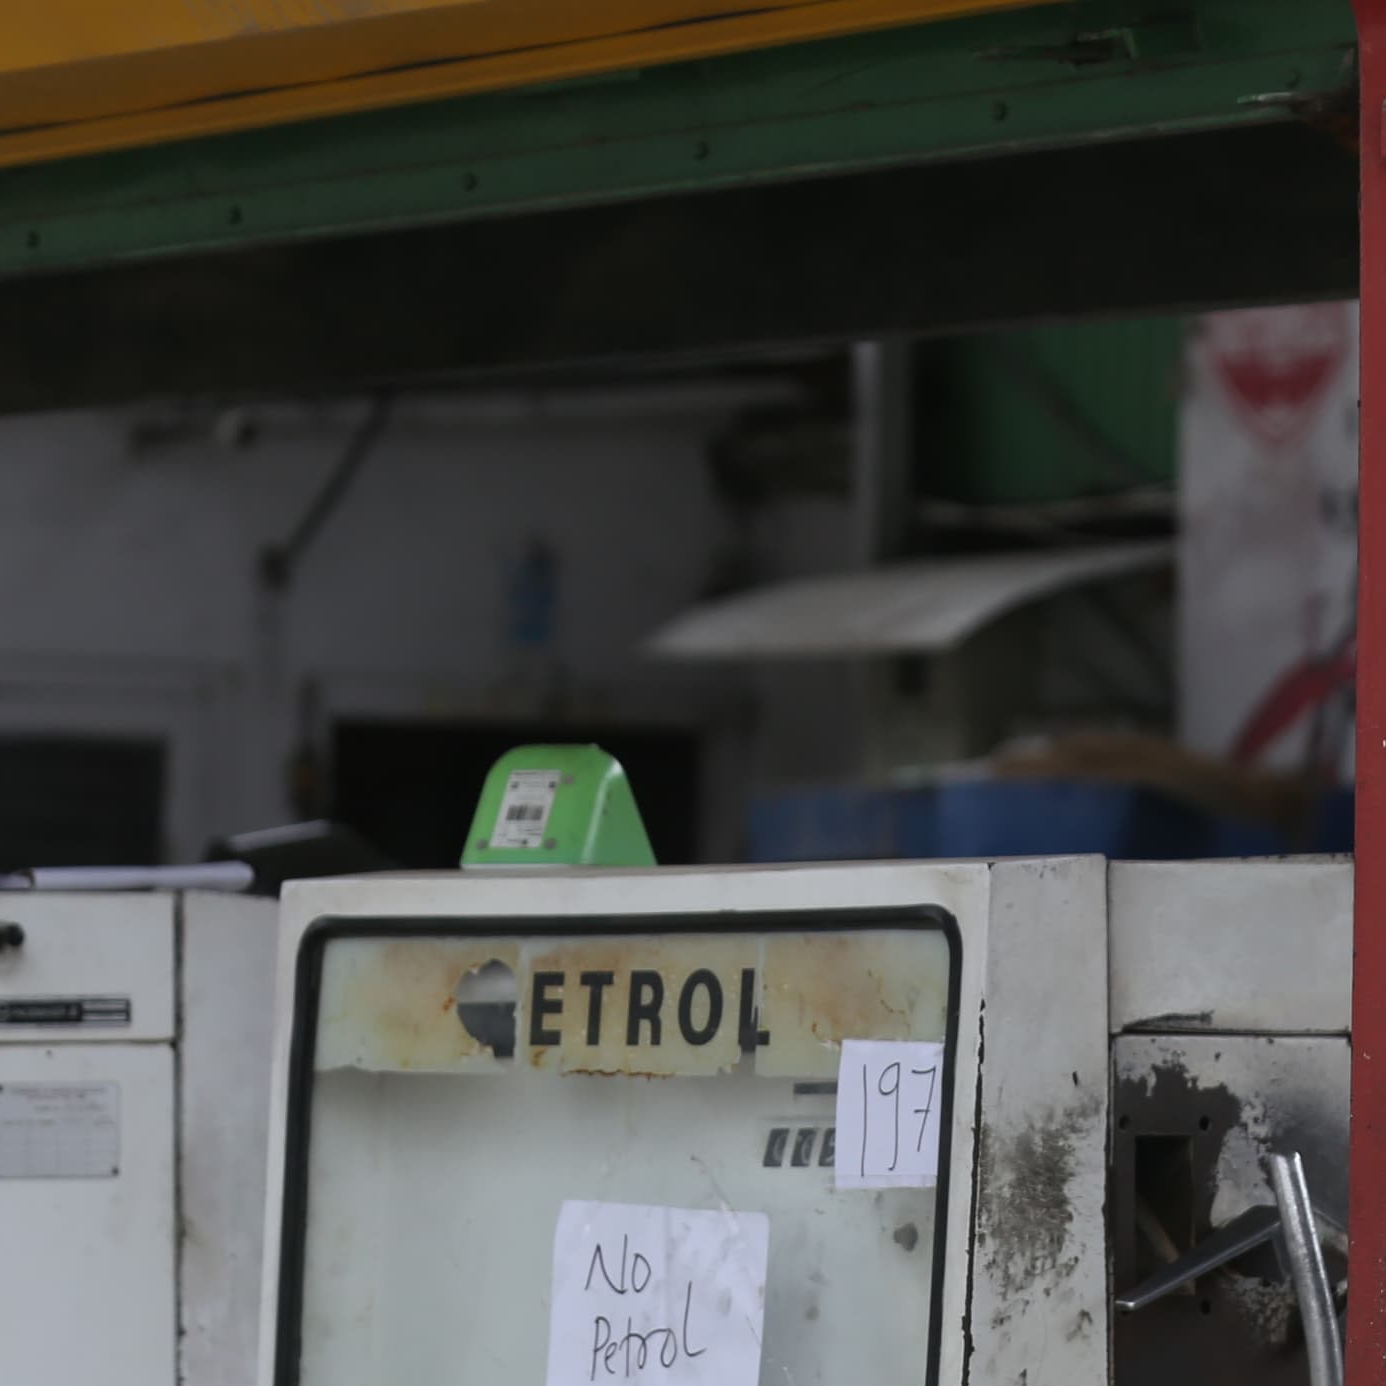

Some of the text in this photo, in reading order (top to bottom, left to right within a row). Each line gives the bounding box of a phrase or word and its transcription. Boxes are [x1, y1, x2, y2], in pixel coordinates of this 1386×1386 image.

[493, 968, 771, 1047] ETROL
[860, 1062, 937, 1178] 197
[584, 1234, 652, 1295] No
[590, 1280, 707, 1381] Petrol
